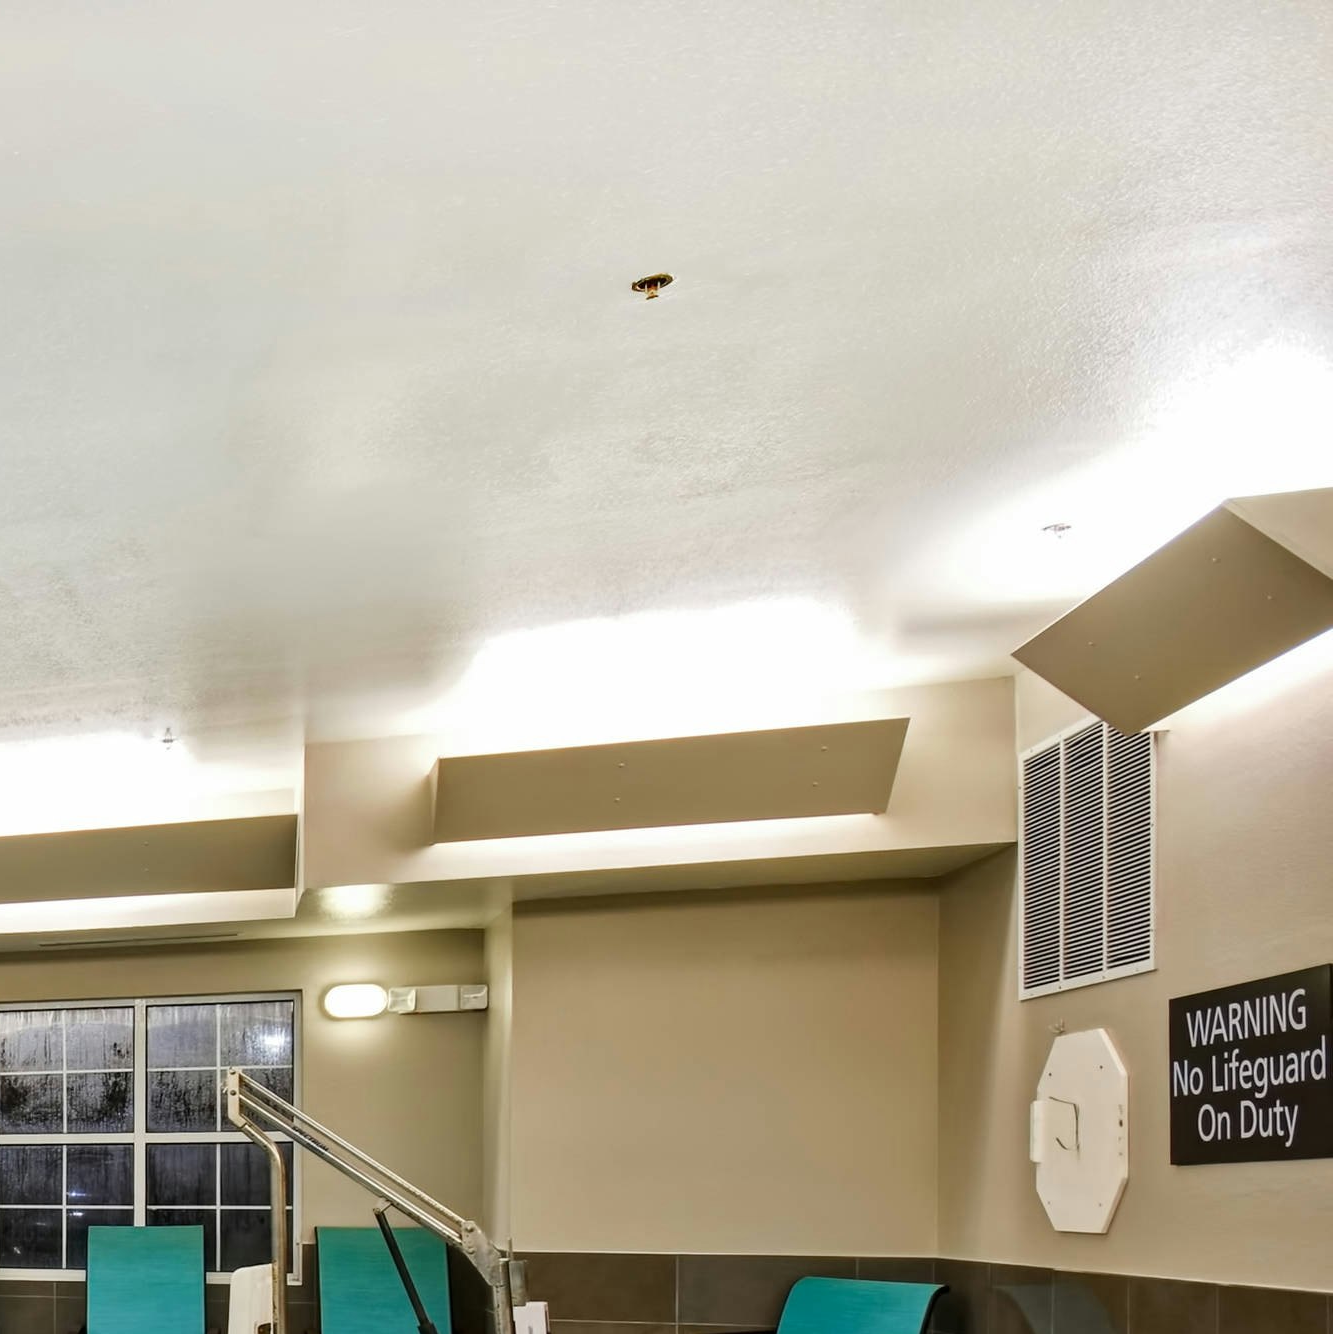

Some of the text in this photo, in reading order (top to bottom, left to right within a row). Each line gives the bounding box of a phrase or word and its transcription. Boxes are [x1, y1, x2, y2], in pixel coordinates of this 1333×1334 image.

[1186, 988, 1307, 1047] WARNING
[1173, 1034, 1327, 1098] No Lifeguard
[1197, 1099, 1299, 1148] On Duty
